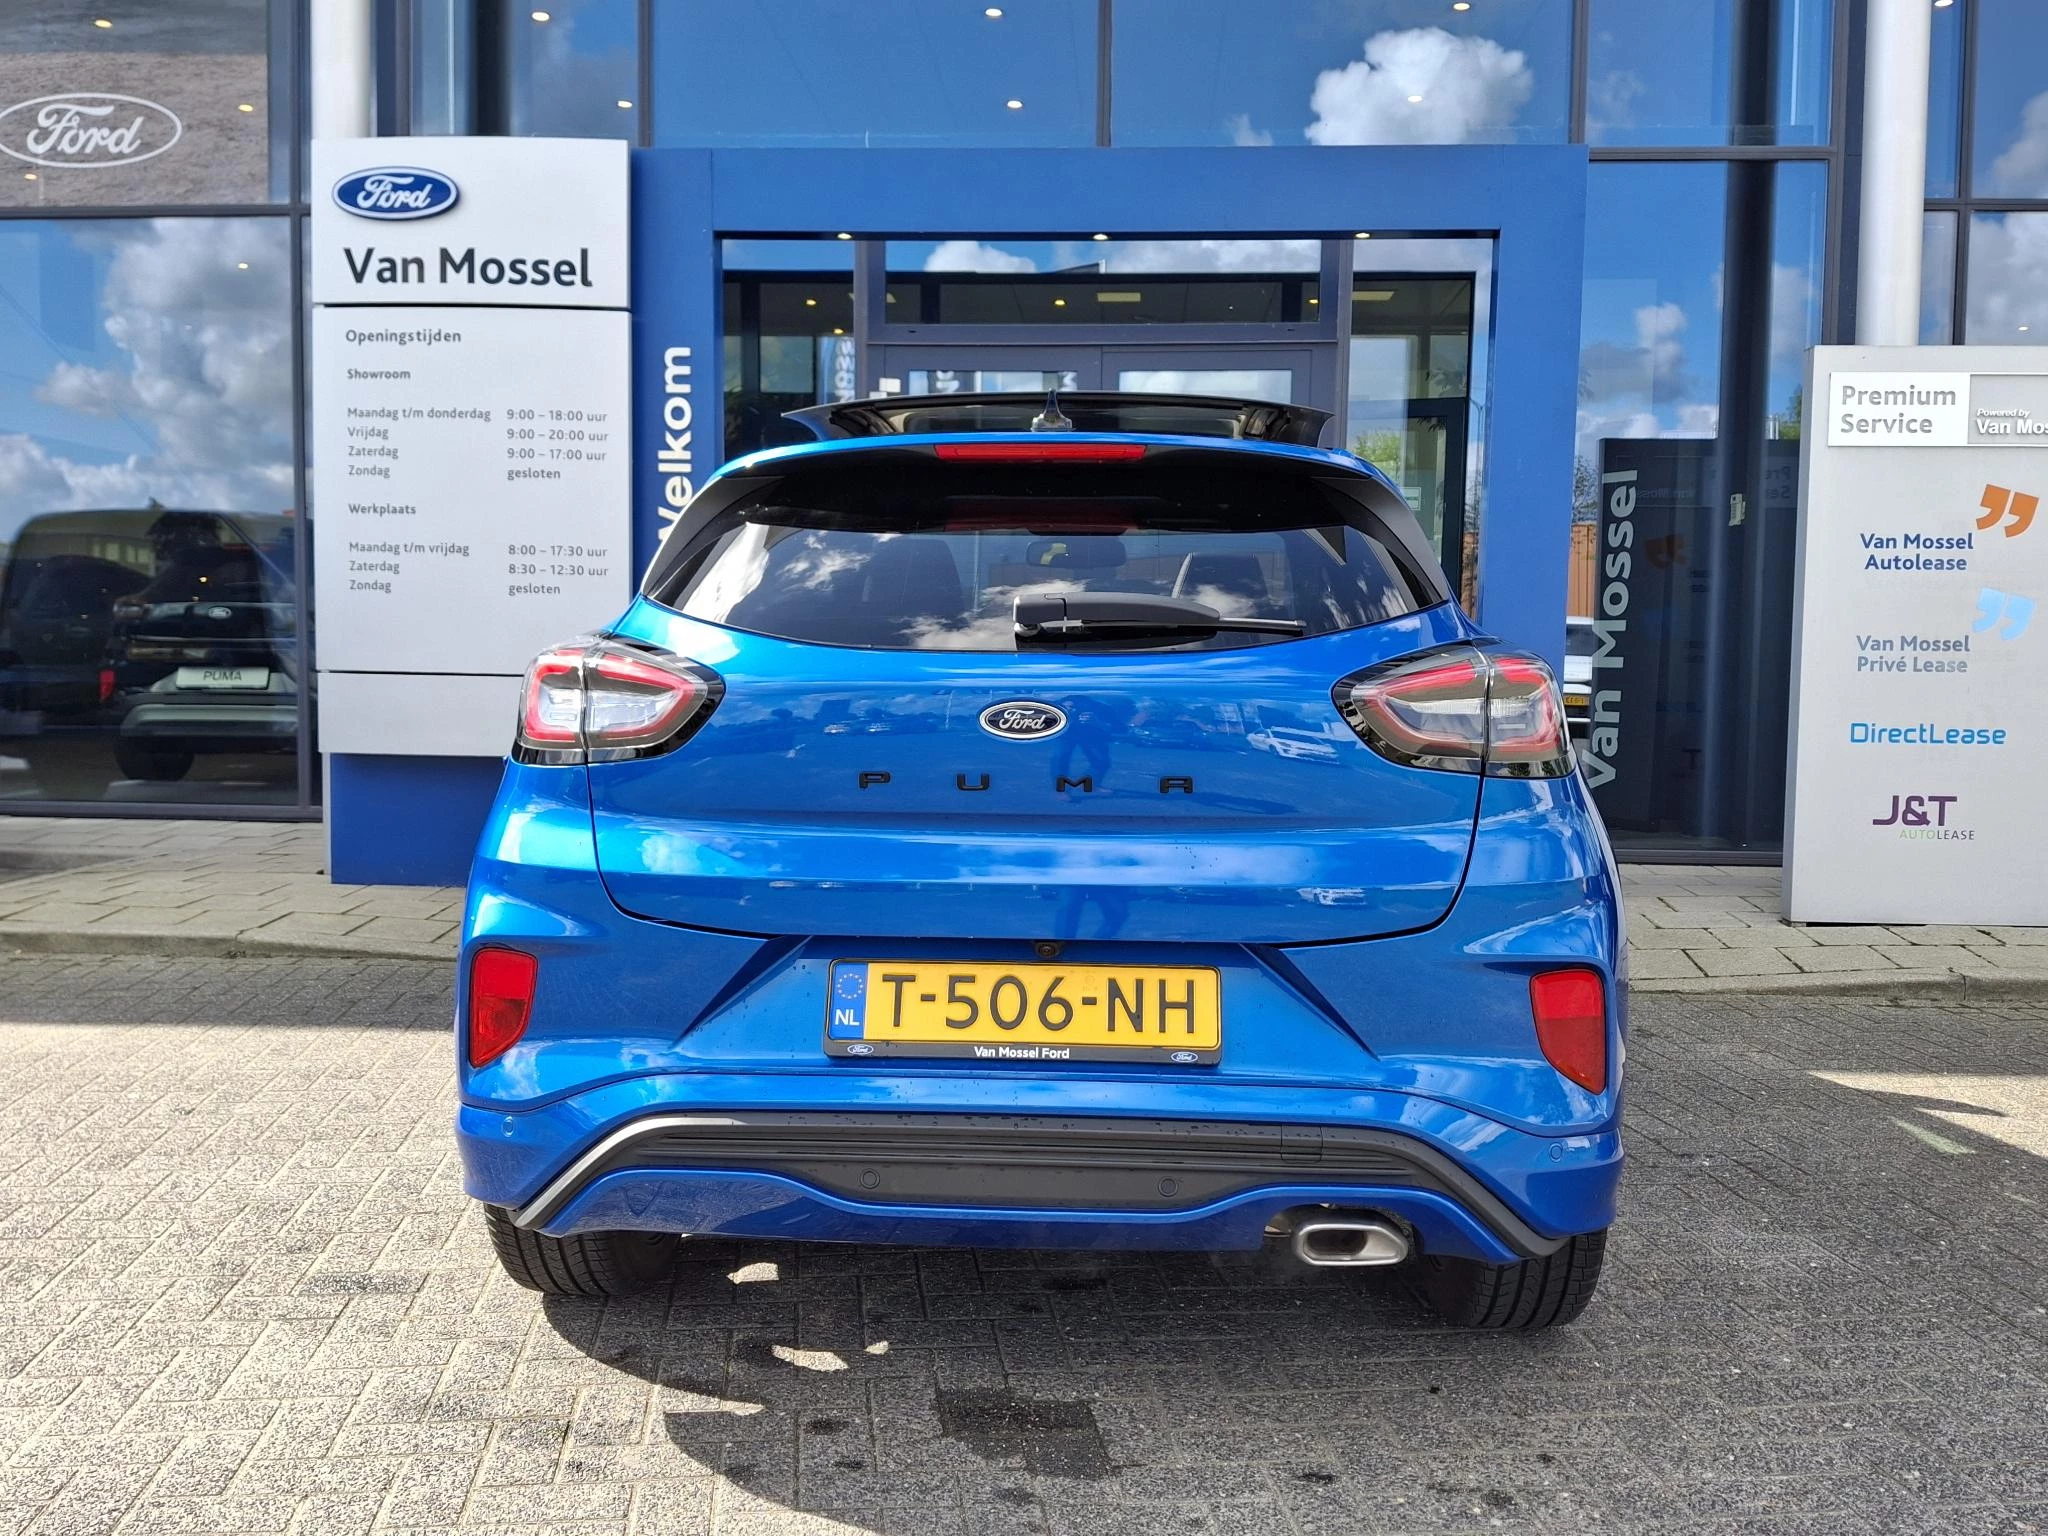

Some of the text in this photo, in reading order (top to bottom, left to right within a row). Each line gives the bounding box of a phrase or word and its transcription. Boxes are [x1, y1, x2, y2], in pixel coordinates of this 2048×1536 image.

[26, 102, 145, 155] Ford
[356, 174, 433, 210] Ford
[343, 246, 593, 288] Van Mossel
[345, 328, 462, 346] Openingstijden
[346, 367, 412, 380] Showroom
[1841, 384, 1957, 406] Premium
[347, 406, 400, 421] Maandag
[401, 407, 424, 419] t/m
[426, 406, 492, 422] donderdag
[506, 408, 535, 421] 9:00
[548, 409, 584, 422] 18:00
[586, 412, 608, 423] uur
[1976, 407, 2031, 419] Powered by
[1840, 412, 1933, 434] Service
[1975, 418, 2011, 435] Van
[347, 426, 389, 441] Vrijdag
[506, 427, 536, 440] 9:00
[548, 428, 585, 441] 20:00
[587, 432, 609, 442] uur
[347, 445, 399, 460] Zaterdag
[506, 447, 536, 460] 9:00
[549, 448, 583, 461] 17:00
[585, 451, 607, 461] uur
[347, 464, 561, 481] Zondag gesloten
[347, 503, 417, 518] Werkplaats
[348, 541, 401, 556] Maandag
[403, 541, 426, 554] t/m
[428, 542, 470, 557] vrijdag
[508, 544, 537, 557] 8:00
[550, 545, 584, 558] 17:30
[586, 548, 608, 558] uur
[1860, 532, 1974, 551] Van Mossel
[348, 560, 401, 575] Zaterdag
[508, 563, 537, 576] 8:30
[549, 564, 585, 577] 12:30
[588, 566, 609, 577] uur
[1864, 553, 1968, 571] Autolease
[349, 579, 561, 596] Zondag gesloten
[1581, 469, 1638, 790] Van Mossel
[1855, 634, 1971, 653] Van Mossel
[1856, 655, 1969, 673] Privé Lease
[202, 670, 243, 682] PUMA
[998, 708, 1047, 731] Ford
[1849, 722, 2007, 745] DirectLease
[858, 771, 1195, 796] PUMA
[1871, 794, 1958, 827] J&T
[1899, 829, 1976, 841] AUTOLEASE
[881, 972, 1196, 1034] T-506-NH
[834, 1008, 861, 1027] NL
[973, 1045, 1070, 1059] Van Mossel Ford
